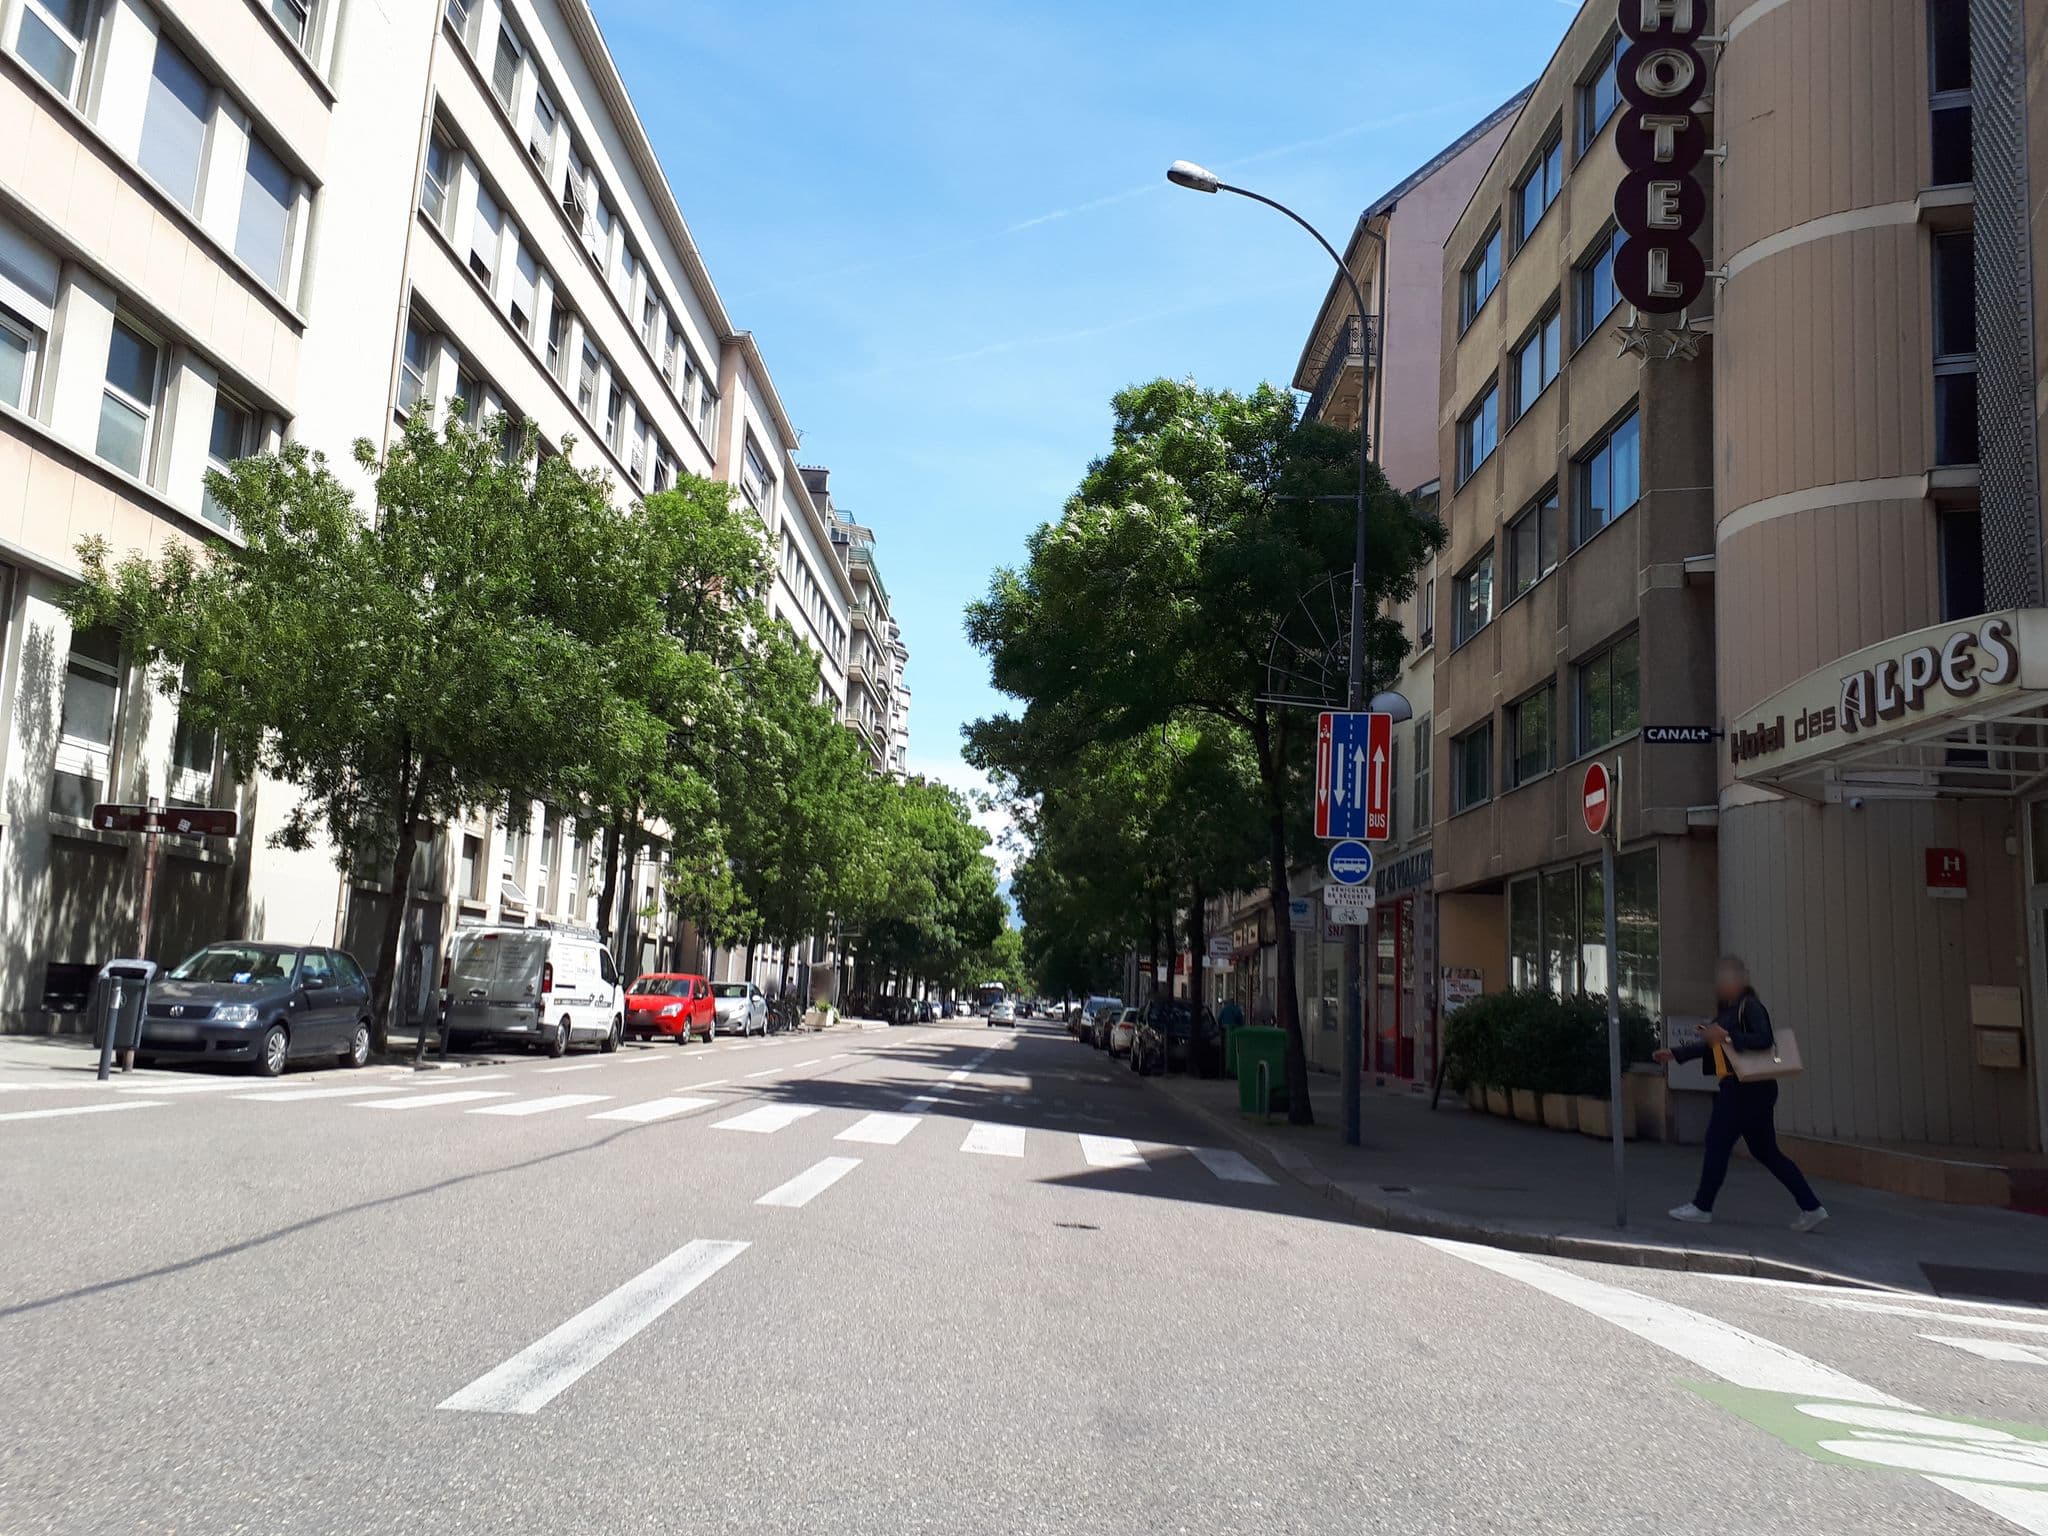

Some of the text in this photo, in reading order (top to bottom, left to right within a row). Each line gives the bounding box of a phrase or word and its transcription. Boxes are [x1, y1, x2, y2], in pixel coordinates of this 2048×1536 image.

[1635, 0, 1695, 298] HOTEL
[1794, 705, 1836, 743] des
[1840, 618, 2019, 734] ALPES
[1647, 727, 1710, 742] CANAL+
[1368, 813, 1386, 828] BUS
[1943, 855, 1961, 872] H
